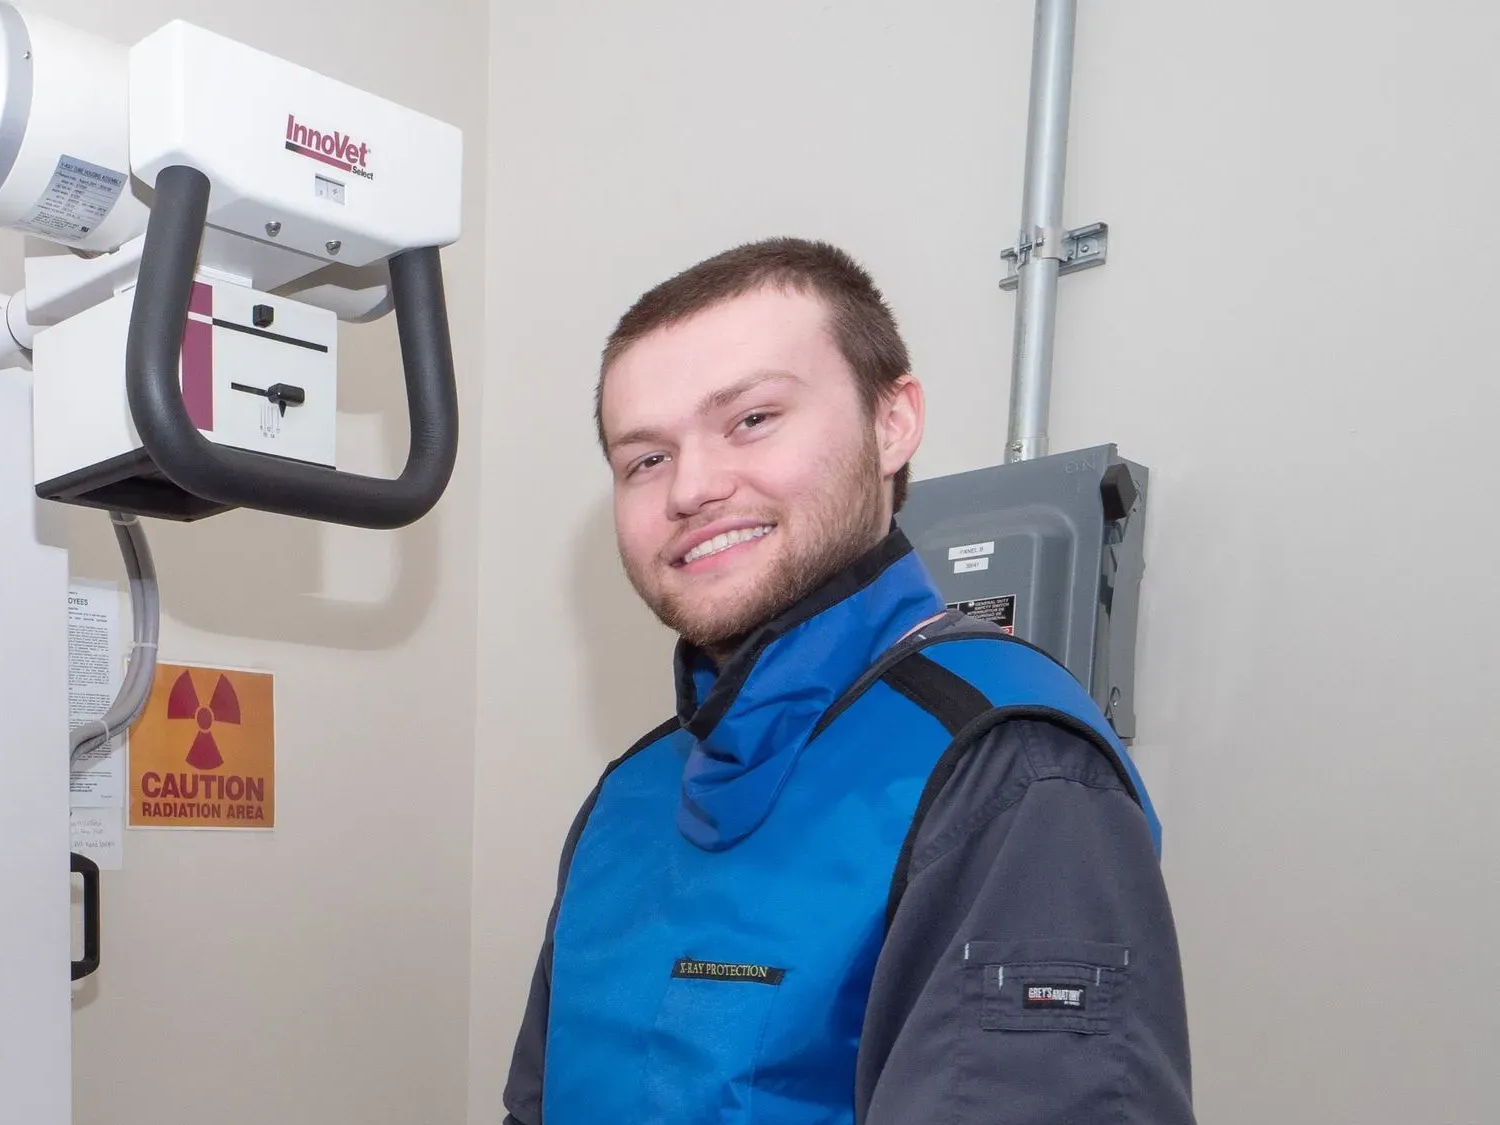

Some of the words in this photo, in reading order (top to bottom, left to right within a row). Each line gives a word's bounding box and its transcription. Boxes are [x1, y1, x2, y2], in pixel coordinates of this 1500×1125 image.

[286, 114, 368, 168] InnoVet
[352, 165, 374, 180] Select
[141, 771, 264, 801] CAUTION
[142, 802, 221, 818] RADIATION
[226, 804, 265, 820] AREA
[680, 962, 705, 974] X-RAY
[706, 963, 769, 977] PROTECTION
